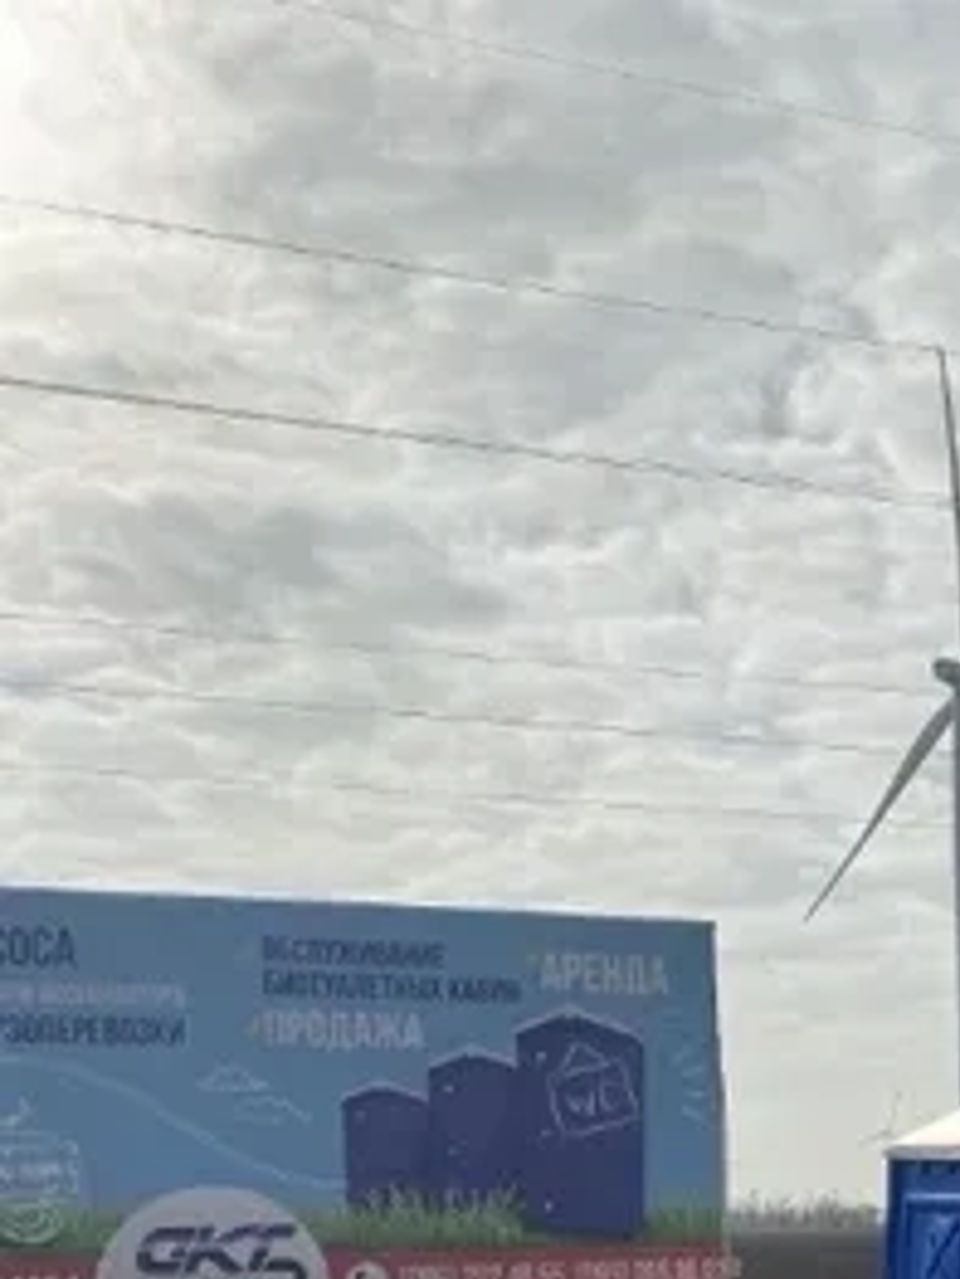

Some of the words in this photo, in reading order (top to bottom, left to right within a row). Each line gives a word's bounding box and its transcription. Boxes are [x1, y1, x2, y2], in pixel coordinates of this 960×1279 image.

[0, 926, 78, 970] ОСА
[541, 953, 669, 996] АРЕНДА
[262, 1009, 424, 1051] ПРОДАЖА
